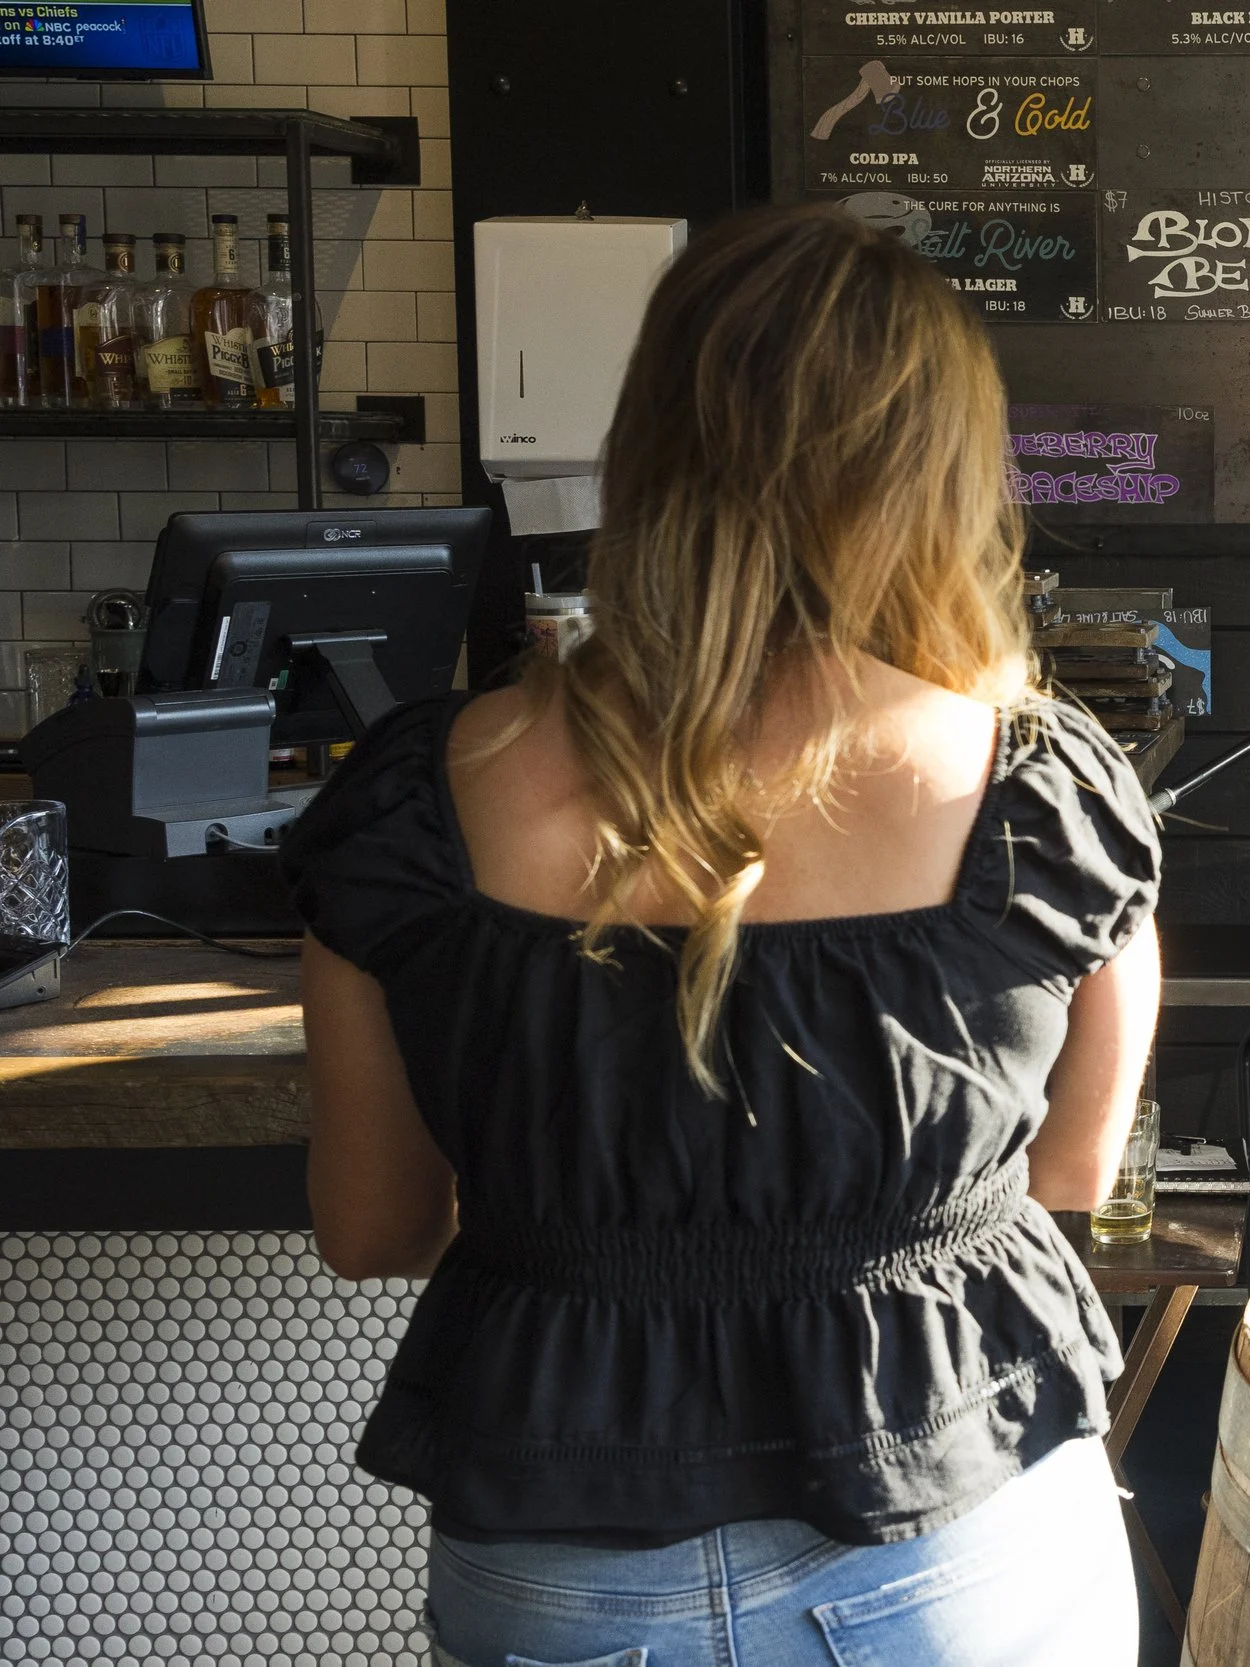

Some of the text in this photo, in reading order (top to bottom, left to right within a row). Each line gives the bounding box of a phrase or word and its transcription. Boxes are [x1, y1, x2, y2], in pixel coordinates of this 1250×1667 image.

[18, 8, 34, 17] vs
[36, 6, 78, 18] Chiefs
[845, 11, 1055, 26] CHERRY VANILLA PORTER
[1191, 12, 1245, 25] BLACK
[4, 20, 122, 35] on NBC peacock
[25, 35, 39, 46] at
[876, 33, 1025, 46] 5.5% ALC/VOL IBU: 16
[1171, 33, 1201, 45] 5.3%
[890, 76, 1080, 87] PUT SOME HOPS IN YOUR CHOPS
[868, 92, 950, 136] Blue
[966, 88, 1003, 140] &
[849, 153, 919, 165] COLD IPA
[984, 166, 1052, 174] NORTHERN
[820, 172, 948, 184] 7% ALC/VOL IBU: 50
[982, 174, 1056, 183] ARIZONA
[903, 200, 1061, 213] THE CURE FOR ANYTHING IS
[1104, 190, 1128, 213] $7
[974, 218, 1076, 271] River
[229, 248, 235, 260] 6
[965, 279, 1018, 292] LAGER
[985, 300, 1026, 312] IBU: 18
[500, 433, 537, 443] winco
[341, 530, 361, 538] NCR
